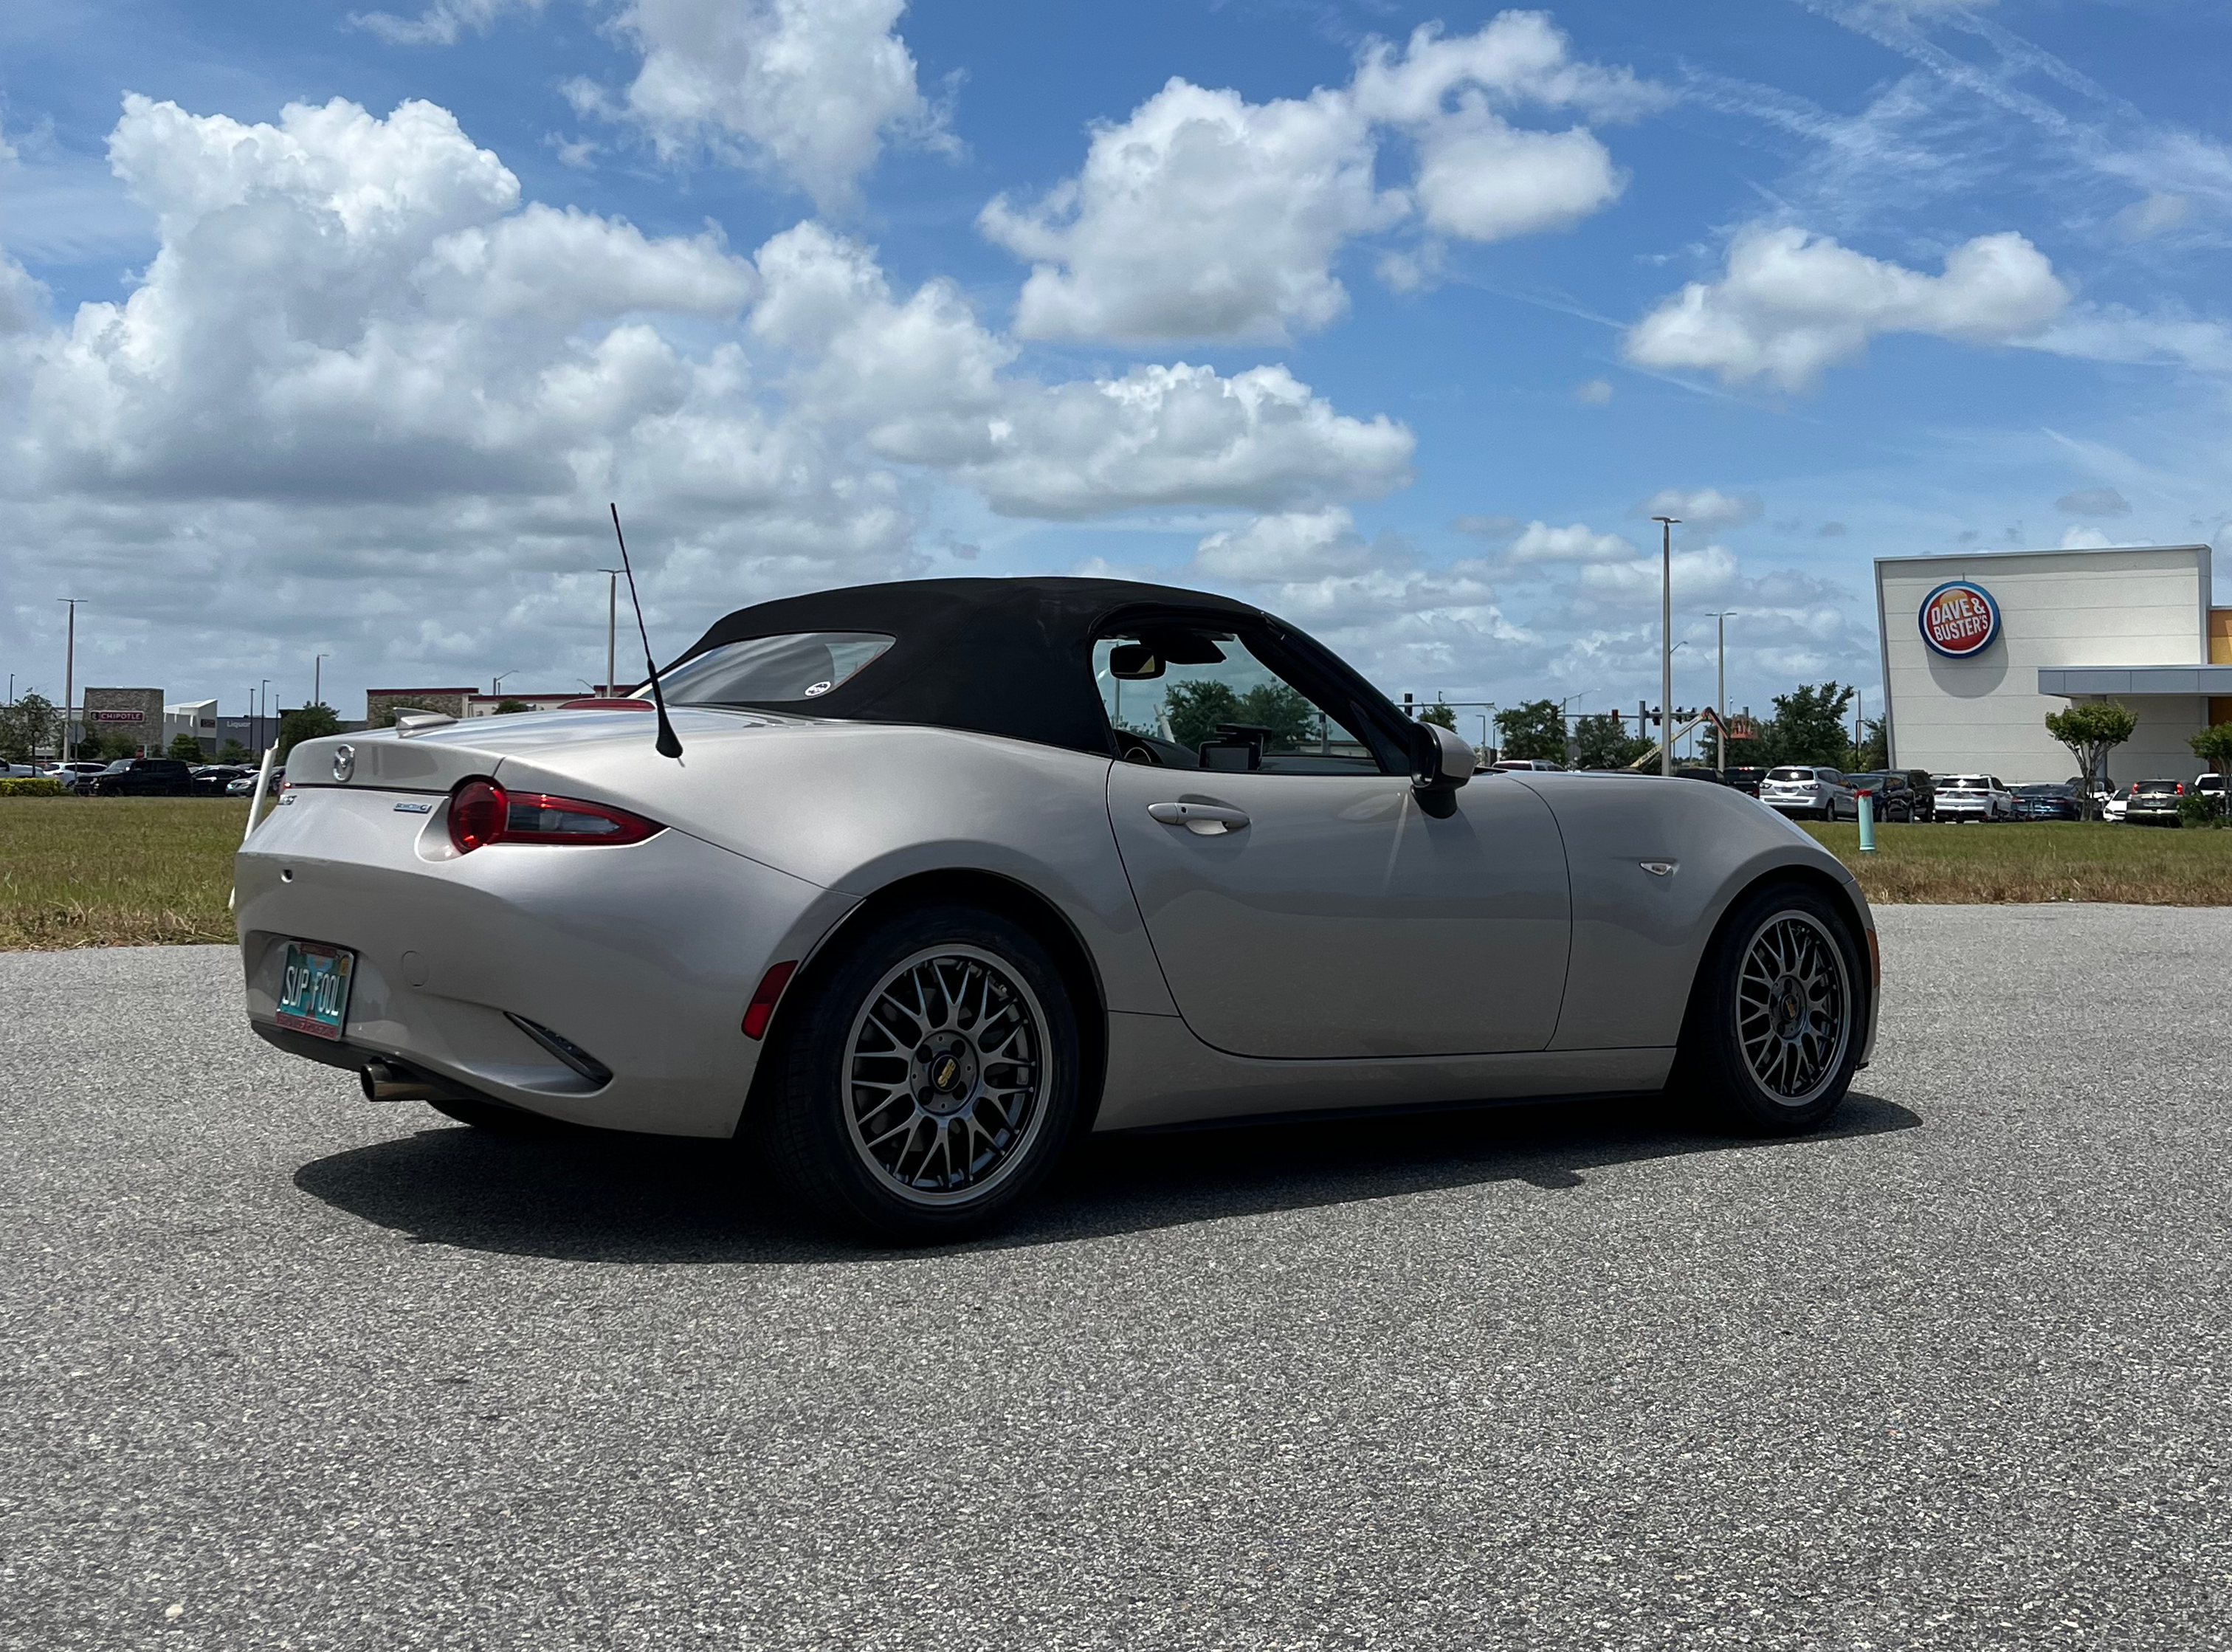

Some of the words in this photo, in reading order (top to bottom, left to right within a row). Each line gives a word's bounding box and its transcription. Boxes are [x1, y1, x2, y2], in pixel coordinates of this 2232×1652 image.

[1931, 598, 1973, 626] DAVE
[1971, 597, 1986, 615] &
[1933, 614, 1988, 642] BUSTER'S
[227, 720, 251, 729] Liquor
[281, 966, 309, 1008] SUP
[311, 971, 340, 1016] FOOL
